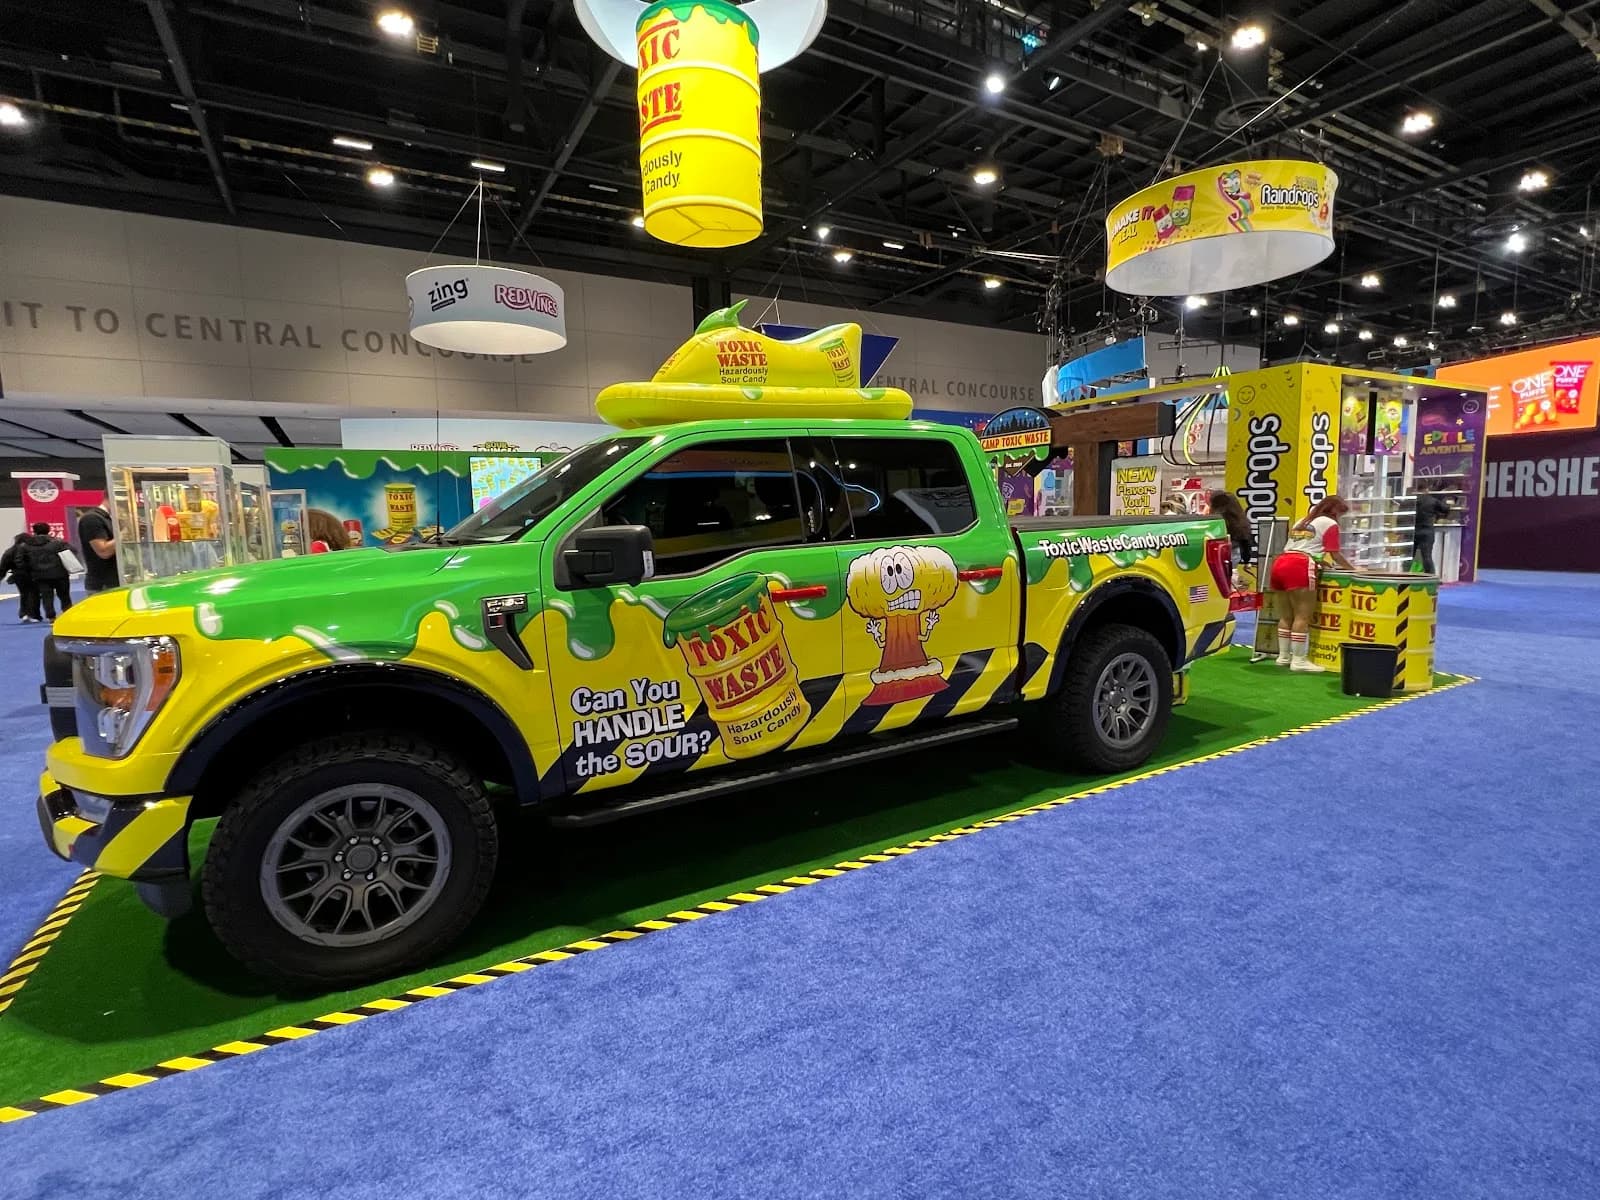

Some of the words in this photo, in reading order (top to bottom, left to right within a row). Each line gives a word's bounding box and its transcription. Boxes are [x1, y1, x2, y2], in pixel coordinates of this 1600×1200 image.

[645, 171, 681, 195] Candy
[1261, 184, 1319, 211] Raindrops
[1112, 208, 1140, 237] MAKE
[1141, 205, 1155, 221] IT
[428, 278, 468, 304] zing
[3, 301, 43, 328] IT
[65, 305, 119, 334] TO
[145, 312, 322, 349] CENTRAL
[716, 340, 763, 353] TOXIC
[716, 353, 768, 367] WASTE
[719, 367, 768, 376] Hazardously
[1553, 364, 1588, 378] ONE
[721, 376, 740, 384] Sour
[743, 375, 767, 384] Candy
[876, 375, 939, 395] ENTRAL
[947, 381, 1035, 401] CONCOURSE
[1512, 370, 1553, 393] ONE
[1520, 388, 1547, 399] PUFFS
[981, 438, 999, 449] CAMP
[1002, 435, 1022, 447] TOXIC
[1024, 431, 1049, 444] WASTE
[1116, 466, 1157, 483] NEW
[389, 493, 413, 501] TOXIC
[1116, 484, 1157, 496] Flavors
[1122, 495, 1150, 508] You'll
[390, 503, 414, 512] WASTE
[1039, 532, 1188, 557] ToxicWasteCandy.com
[688, 604, 772, 667] TOXIC
[705, 643, 785, 703] WASTE
[571, 686, 627, 715] Can
[630, 678, 679, 705] You
[727, 688, 797, 734] Hazardously
[573, 703, 686, 748] HANDLE
[733, 731, 763, 745] Sour
[767, 703, 801, 733] Candy
[575, 751, 621, 777] the
[625, 730, 712, 768] SOUR?
